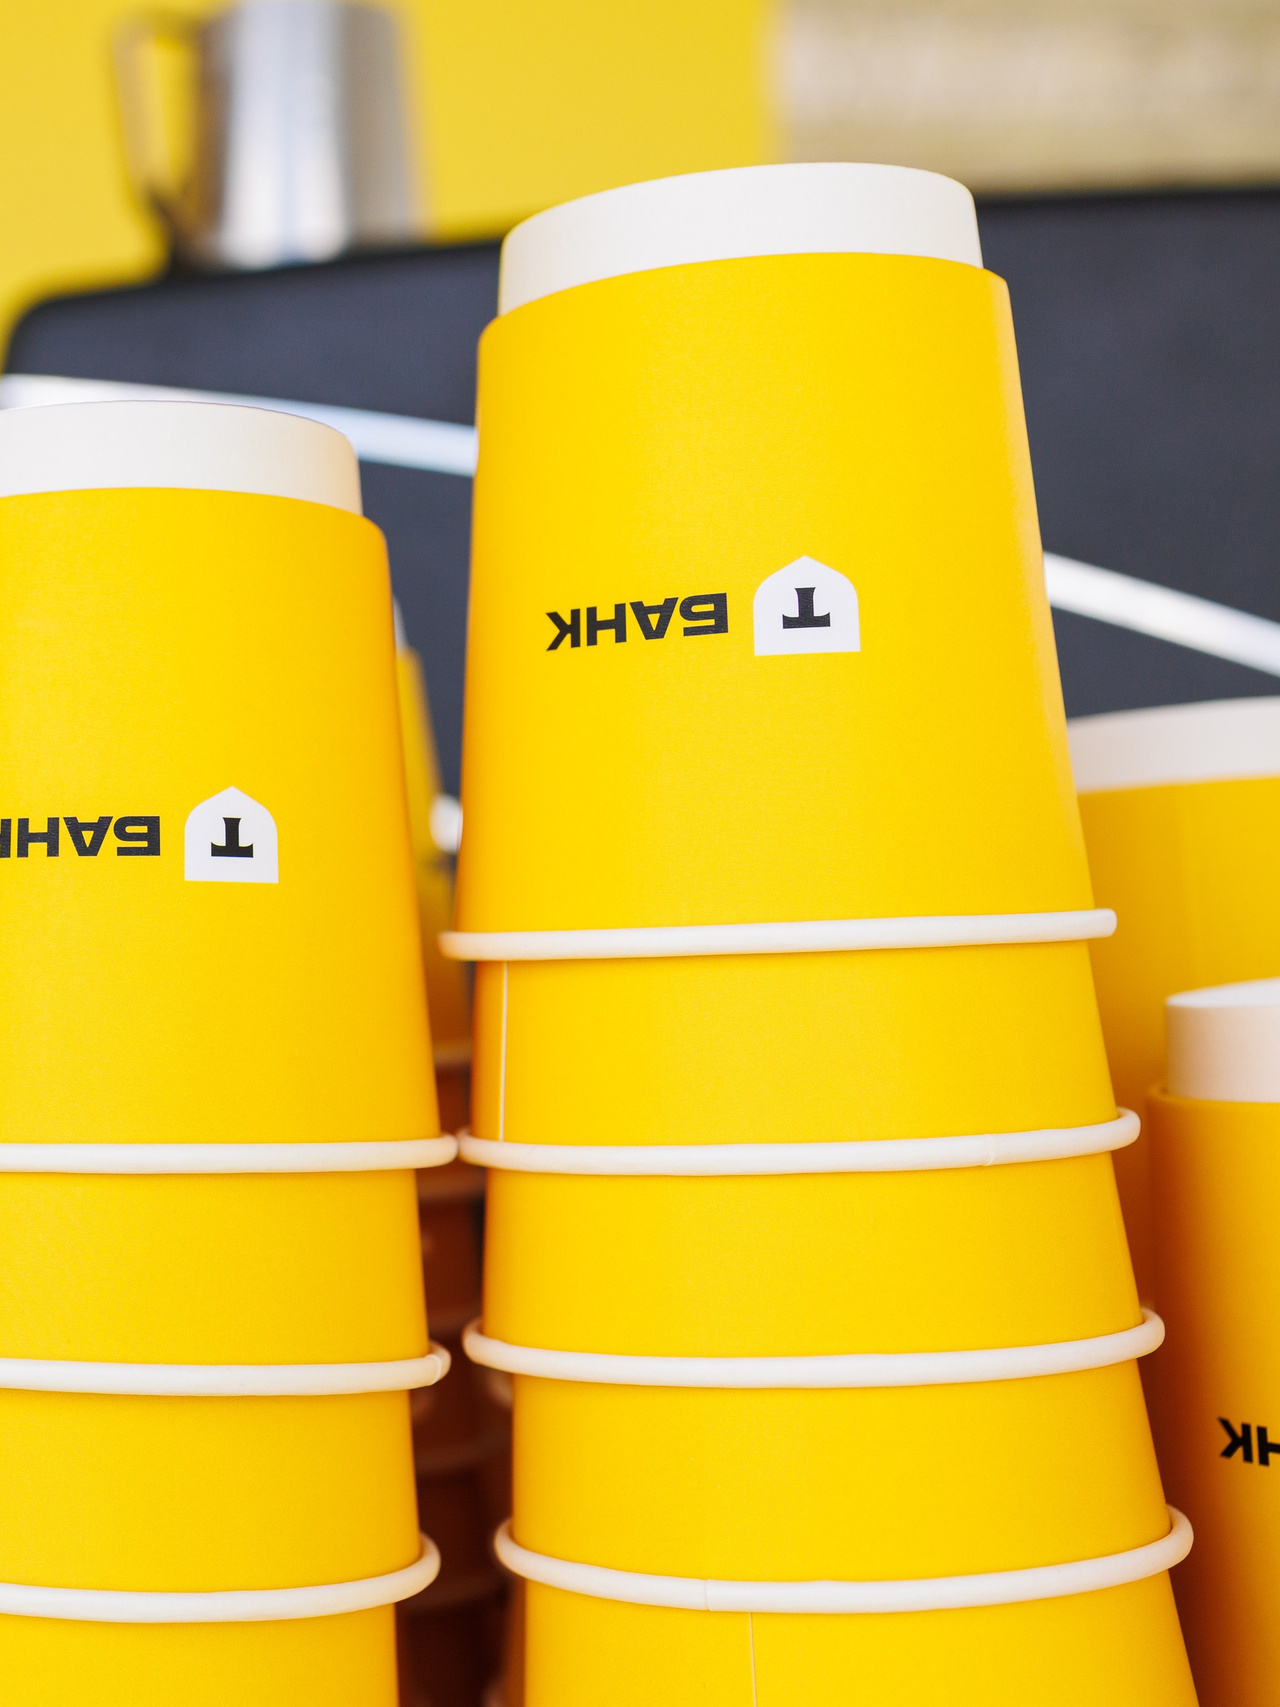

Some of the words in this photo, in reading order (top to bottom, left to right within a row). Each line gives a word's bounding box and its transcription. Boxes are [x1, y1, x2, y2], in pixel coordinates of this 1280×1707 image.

[545, 592, 729, 652] БАНК
[781, 586, 832, 630] Т
[210, 816, 254, 858] Т
